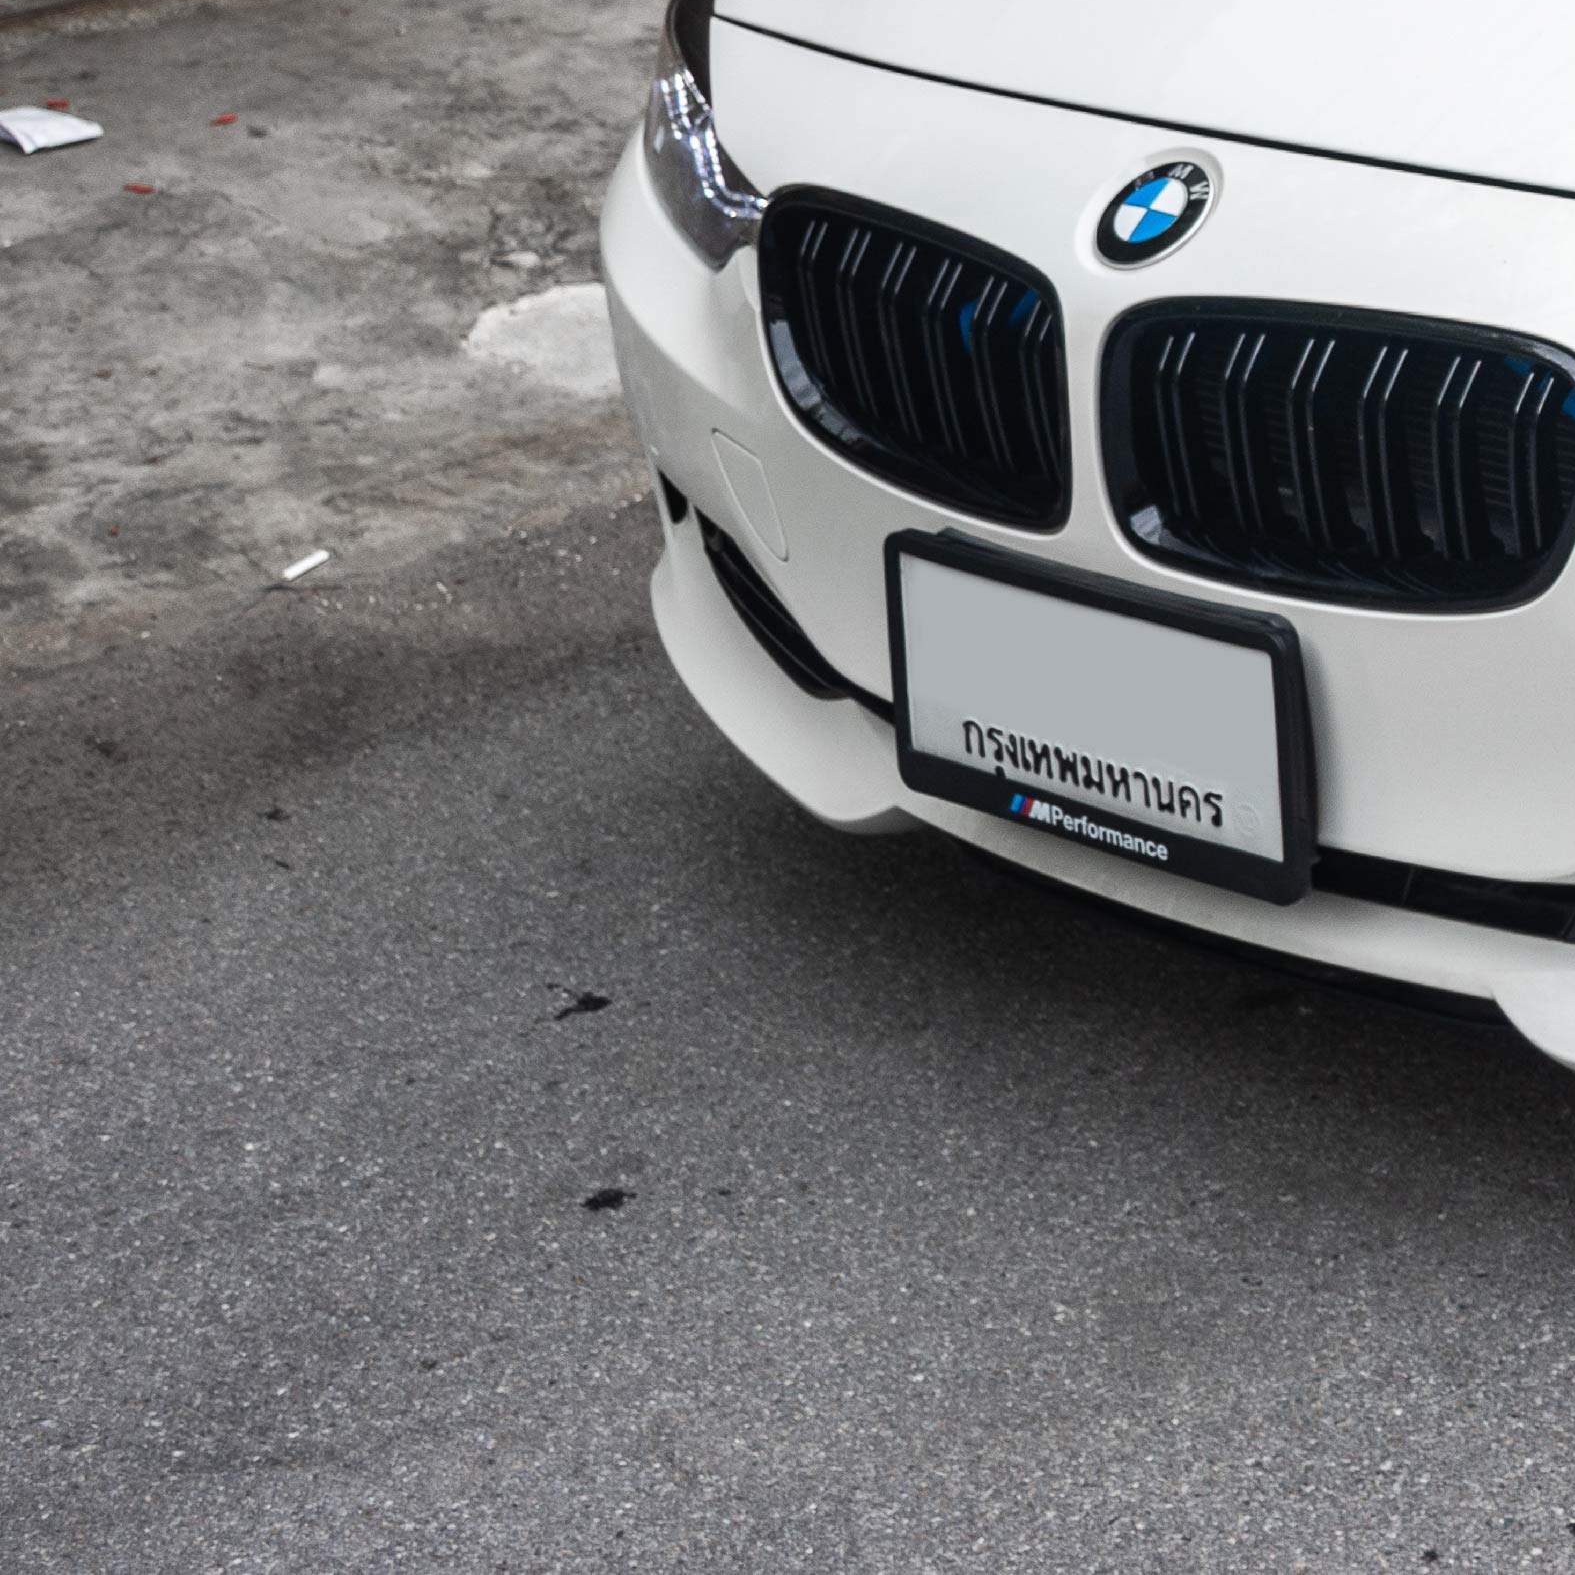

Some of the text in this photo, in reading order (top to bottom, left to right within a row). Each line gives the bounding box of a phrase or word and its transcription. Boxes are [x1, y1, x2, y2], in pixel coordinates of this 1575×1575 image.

[962, 719, 1224, 828] กรุงเทพมหานคร
